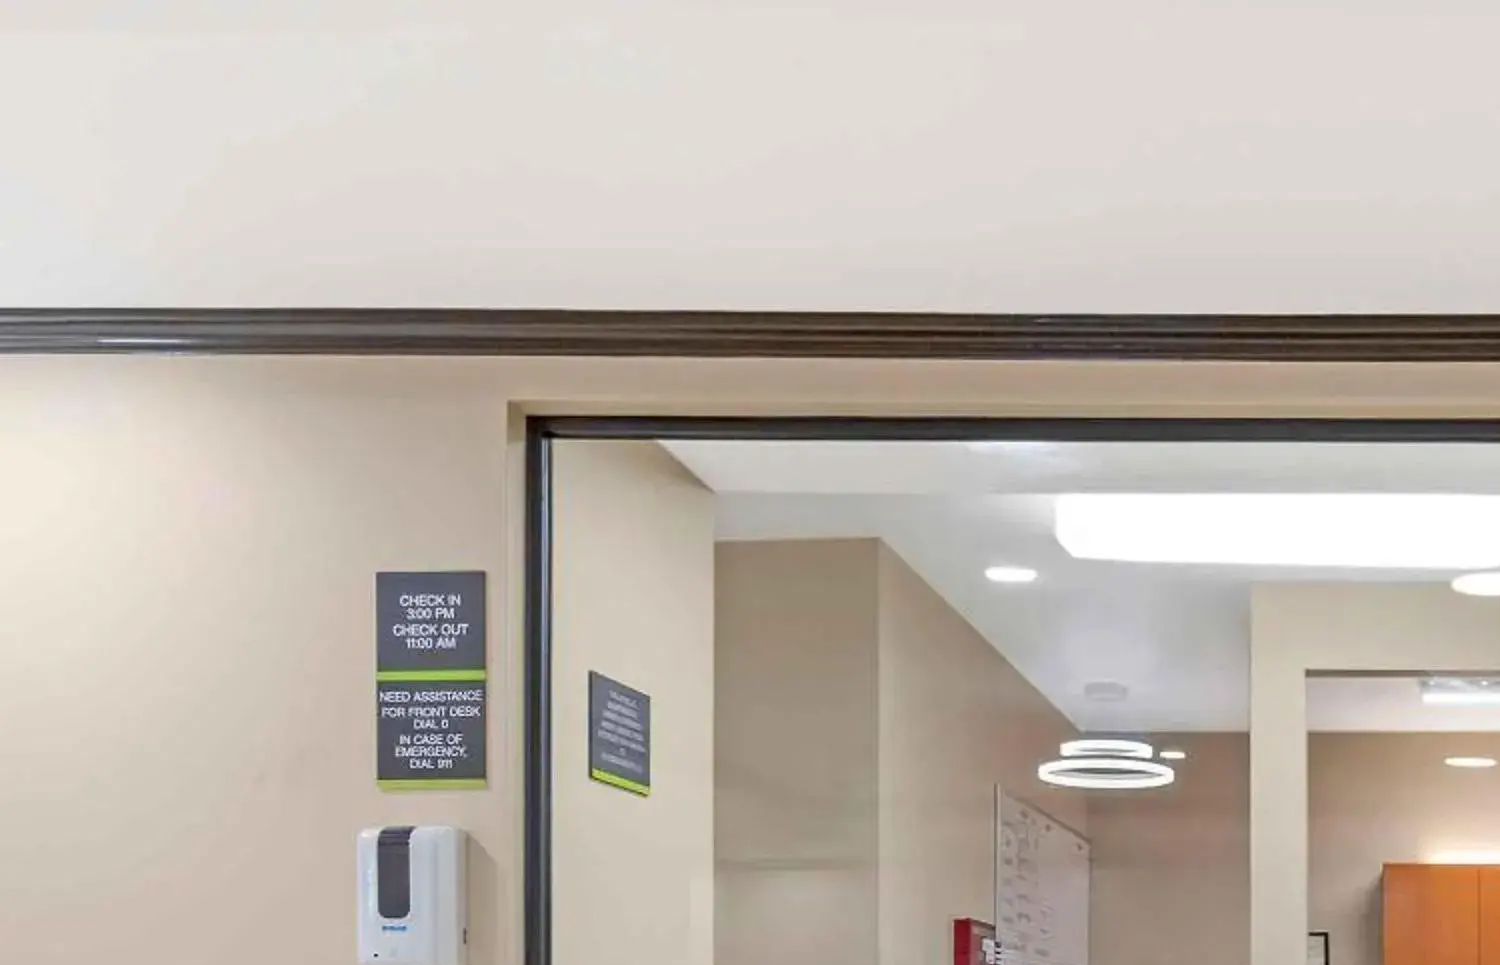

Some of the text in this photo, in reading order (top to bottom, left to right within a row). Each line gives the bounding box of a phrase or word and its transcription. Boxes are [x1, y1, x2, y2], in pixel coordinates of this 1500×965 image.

[399, 594, 461, 607] CHECK IN
[406, 607, 455, 619] 3:00 PM
[393, 623, 469, 636] CHECK OUT
[405, 637, 457, 649] 11:00 AM
[379, 690, 484, 703] NEED ASSISTANCE
[381, 705, 481, 718] FOR FRONT DESK
[413, 719, 449, 730] DIAL 0
[399, 733, 464, 745] IN CASE OF
[409, 758, 453, 769] DIAL 911
